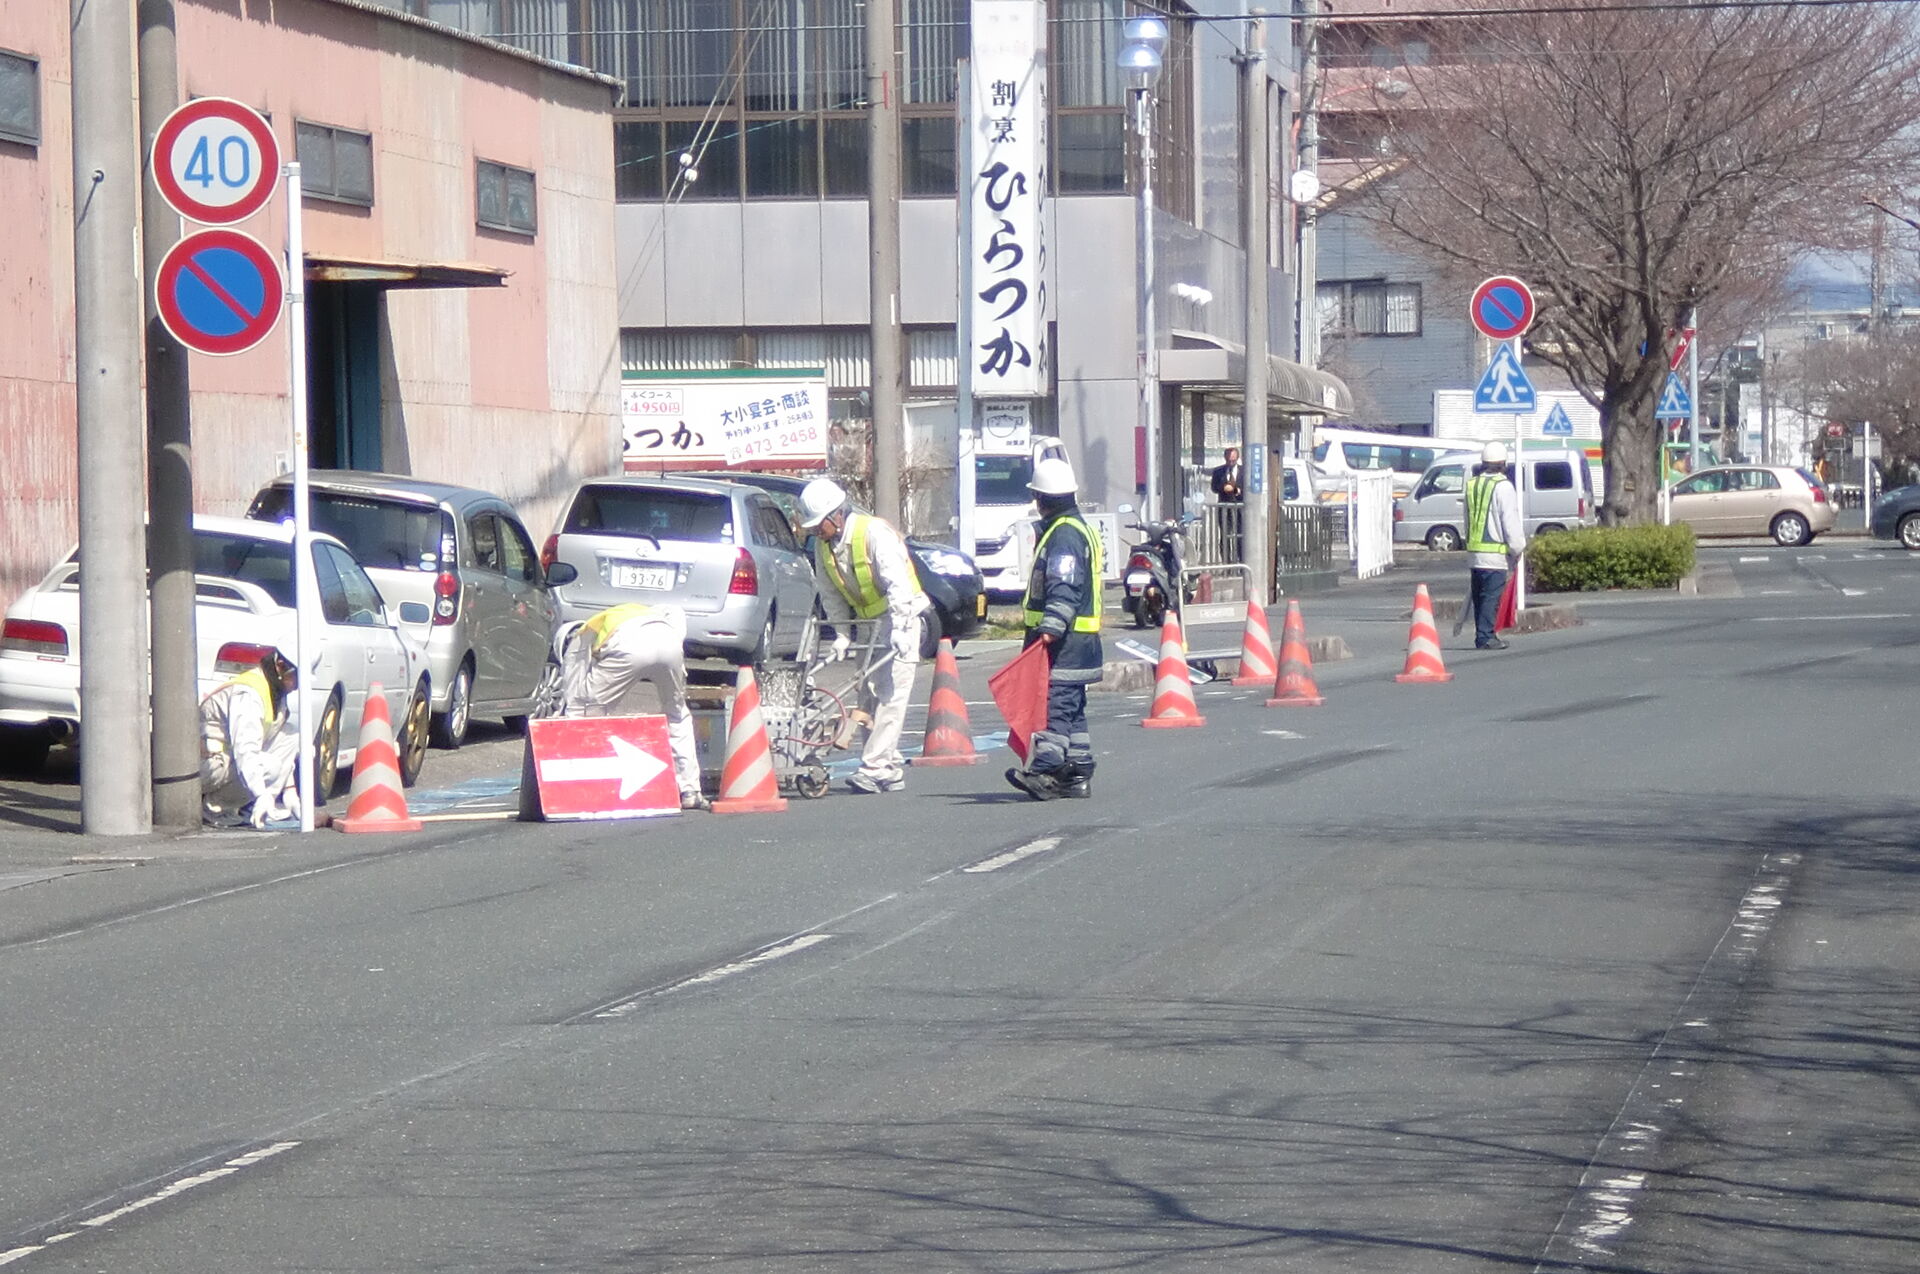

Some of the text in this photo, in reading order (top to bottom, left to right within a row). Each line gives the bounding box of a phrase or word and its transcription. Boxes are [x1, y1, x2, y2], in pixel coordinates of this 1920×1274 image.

[183, 135, 251, 188] 40
[978, 161, 1033, 378] ひらつか
[623, 420, 704, 452] つか
[745, 427, 818, 455] 473 2458
